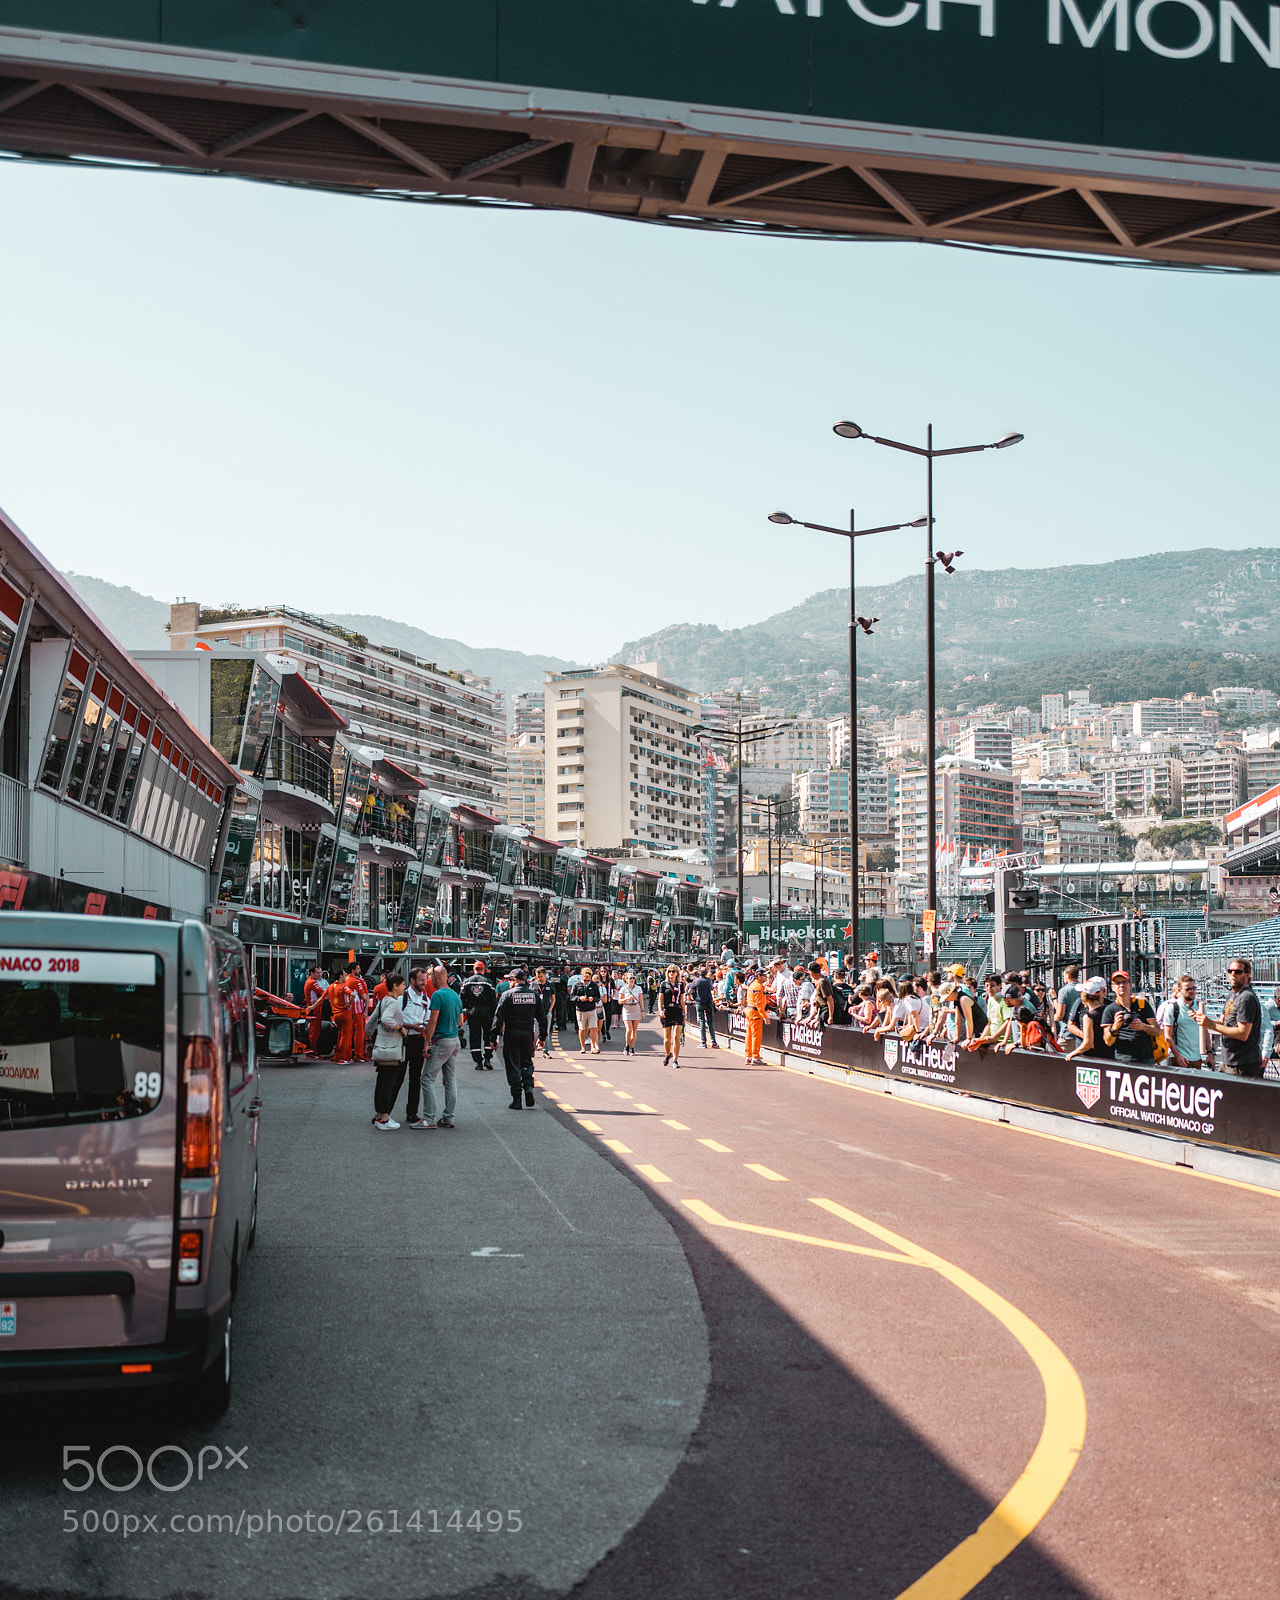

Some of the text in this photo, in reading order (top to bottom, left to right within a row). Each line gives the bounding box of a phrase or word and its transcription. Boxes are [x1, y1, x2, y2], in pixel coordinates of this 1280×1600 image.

[760, 926, 836, 940] Heineken
[0, 957, 80, 972] NACO 2018
[134, 1071, 161, 1098] 89
[1078, 1070, 1099, 1085] TAG
[1106, 1070, 1223, 1119] TAGHeuer
[1110, 1105, 1215, 1135] OFFICIAL WATCH MONACO GP
[65, 1179, 152, 1190] RENAULT
